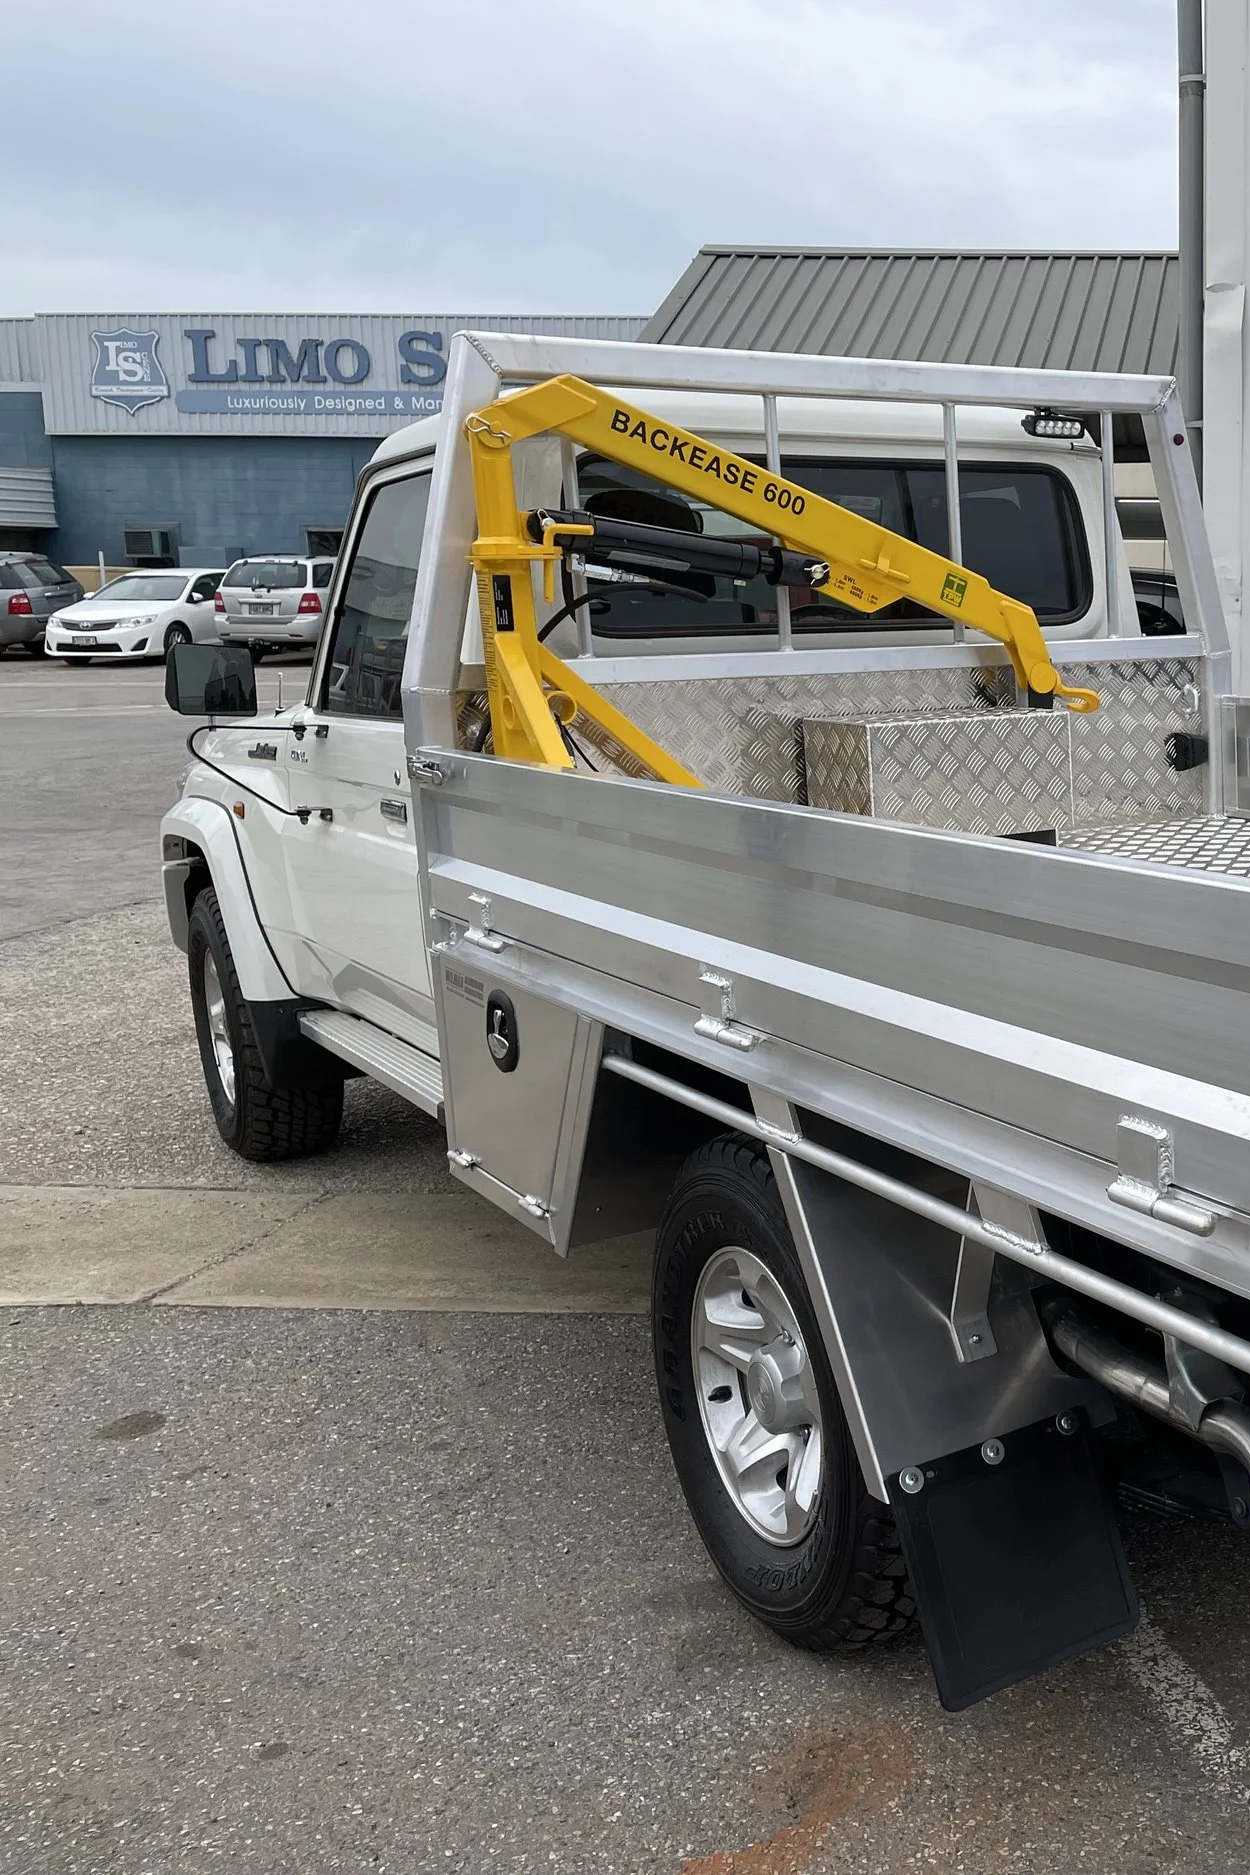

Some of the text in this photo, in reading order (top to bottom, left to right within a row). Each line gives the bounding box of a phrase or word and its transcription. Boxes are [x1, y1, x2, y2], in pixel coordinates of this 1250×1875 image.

[184, 329, 371, 385] LIMO
[227, 395, 307, 411] Luxuriously
[314, 395, 386, 412] Designed
[394, 396, 405, 409] &
[610, 408, 805, 515] BACKEASE 600
[843, 574, 857, 585] SWL
